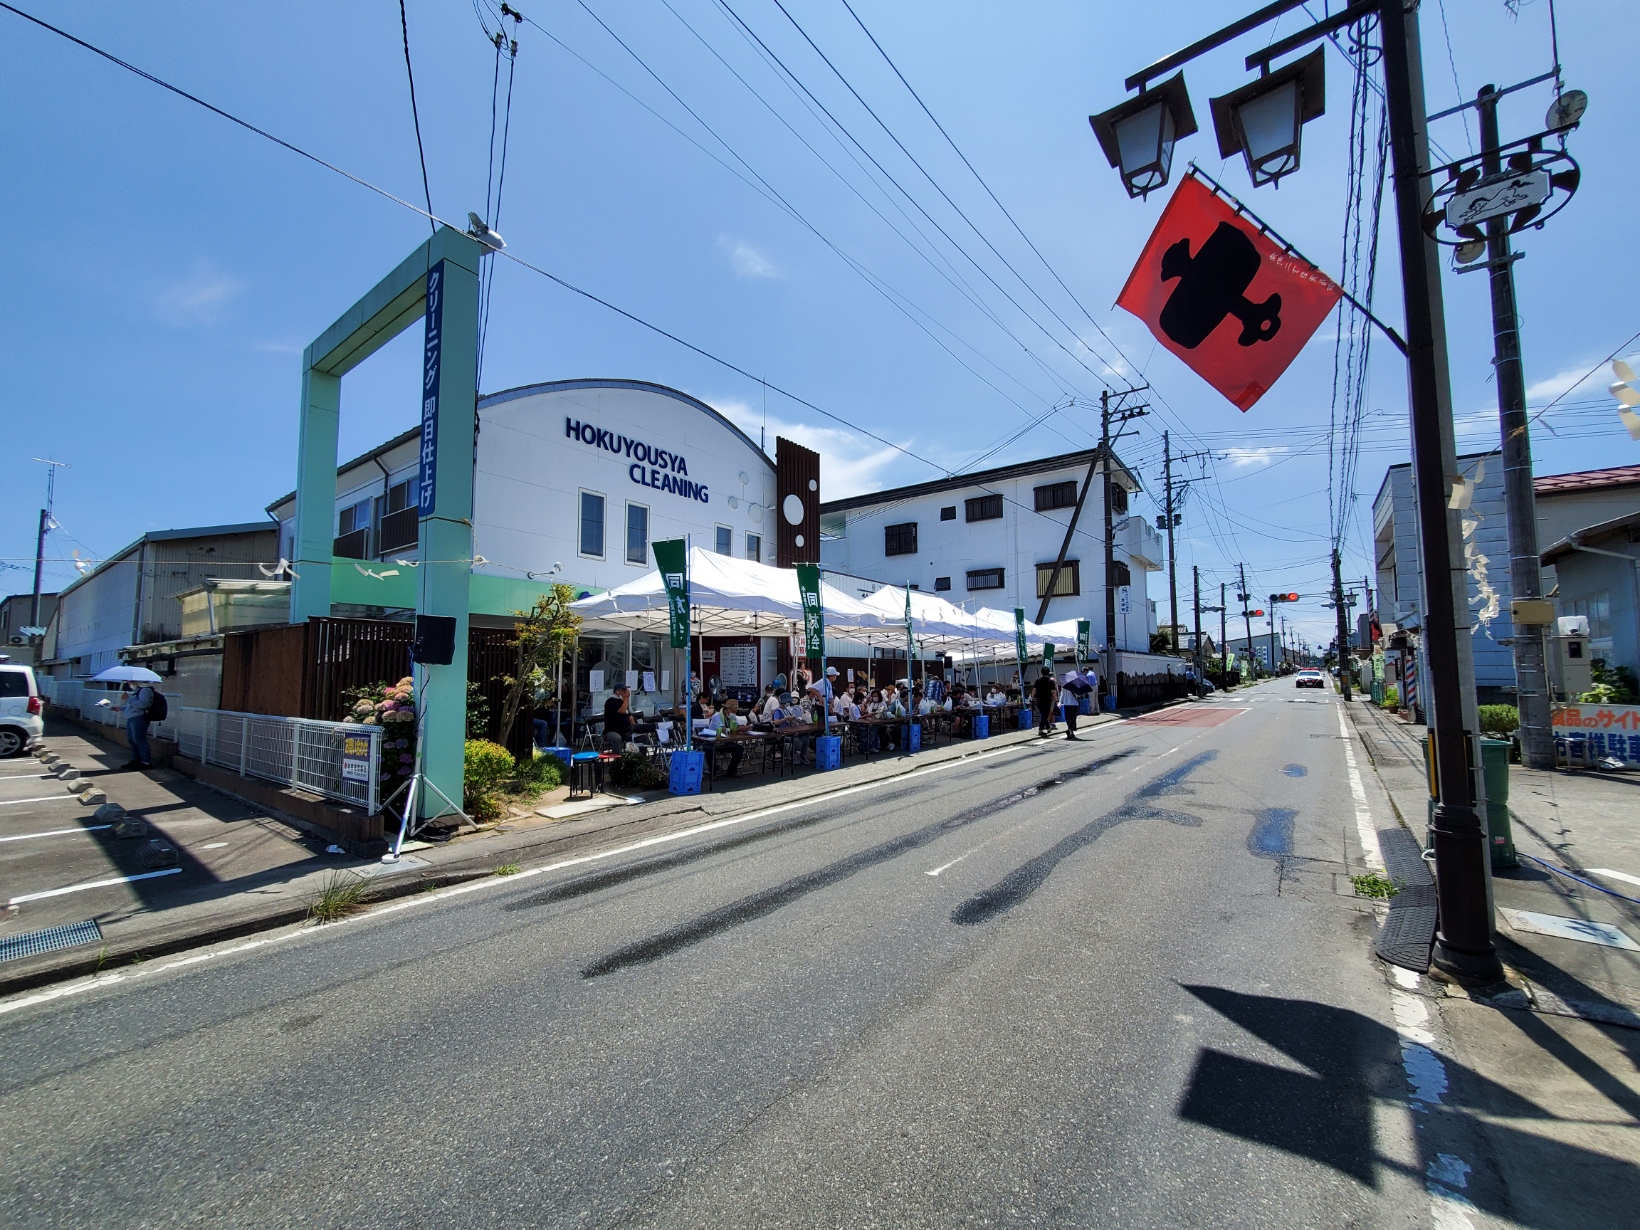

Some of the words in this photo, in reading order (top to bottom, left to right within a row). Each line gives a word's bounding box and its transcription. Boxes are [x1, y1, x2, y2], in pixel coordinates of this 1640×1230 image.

[425, 271, 440, 390] クリーニング
[420, 395, 436, 509] 即日仕上げ
[565, 416, 689, 477] HOKUYOUSYA
[629, 463, 709, 504] CLEANING
